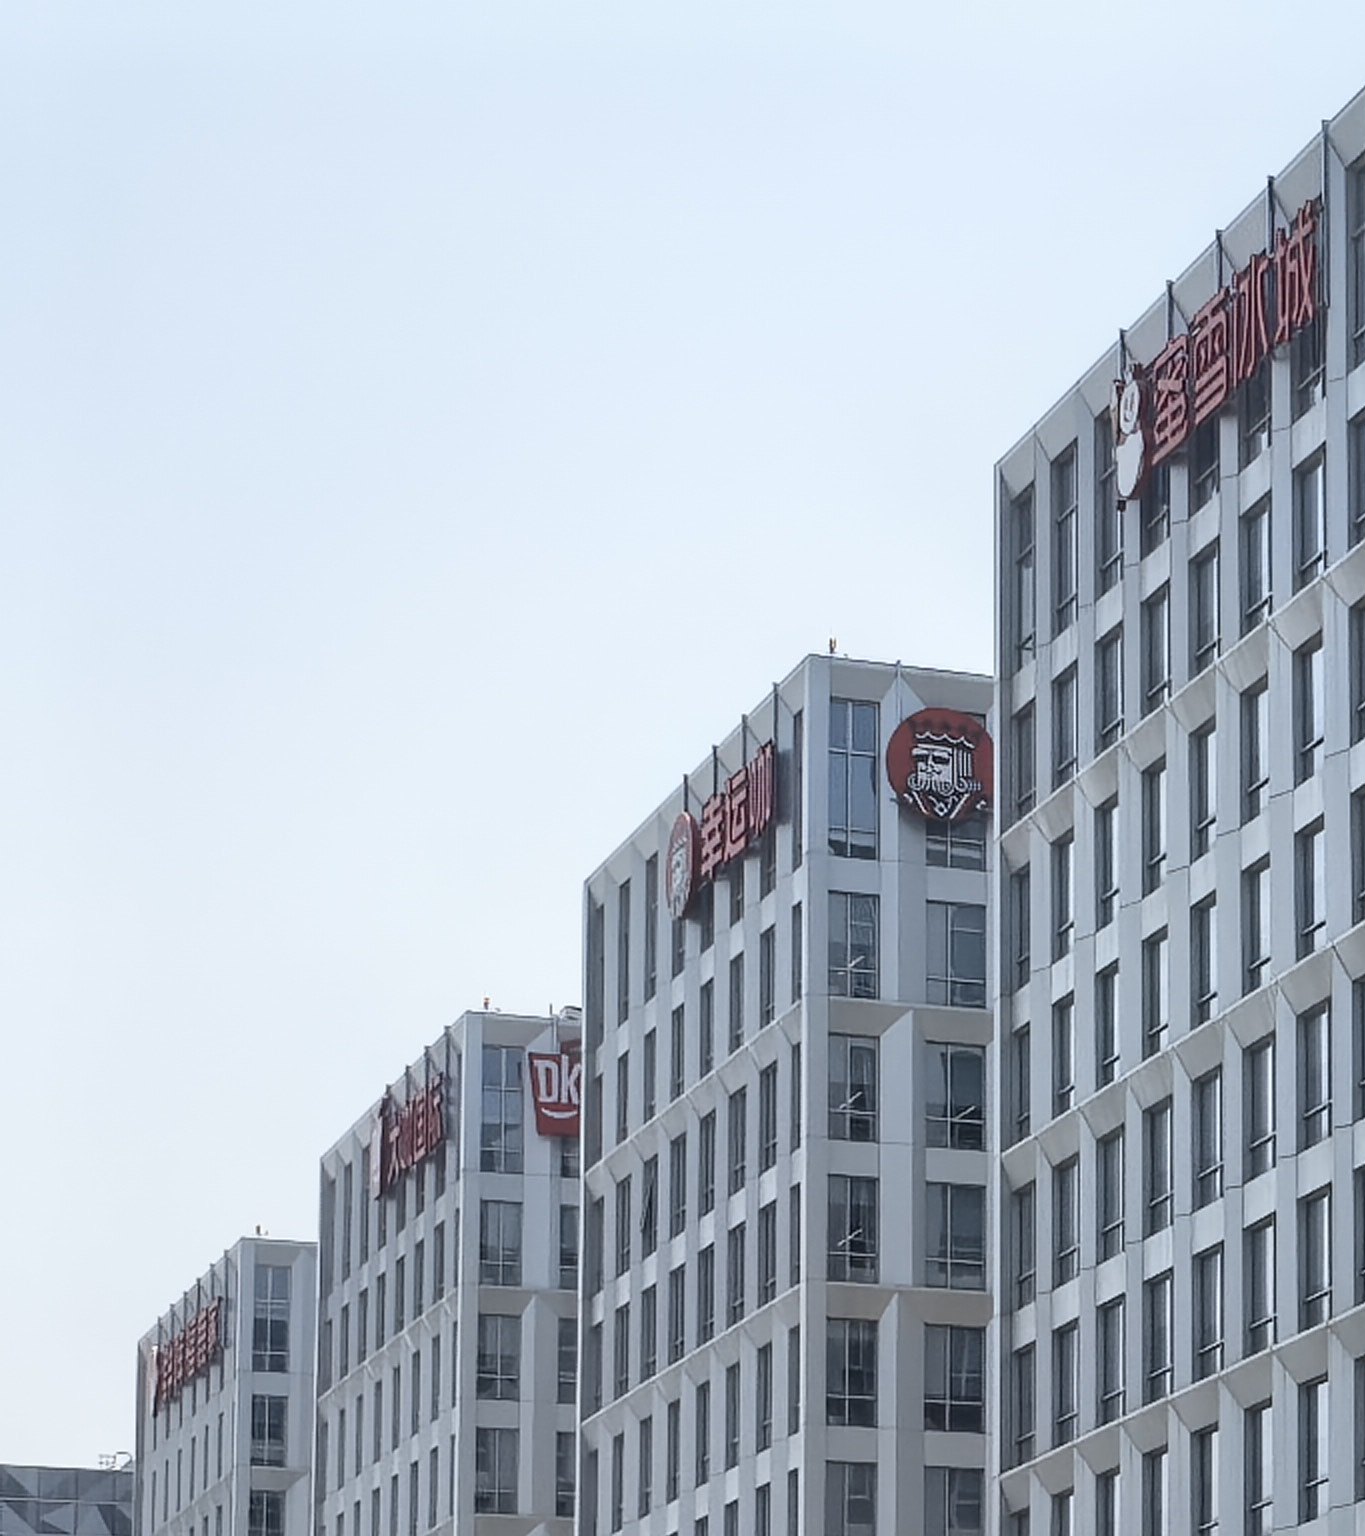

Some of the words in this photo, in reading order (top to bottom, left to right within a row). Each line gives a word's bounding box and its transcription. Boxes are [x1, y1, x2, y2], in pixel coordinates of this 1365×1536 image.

[1151, 199, 1320, 466] 蜜雪冰城
[700, 740, 774, 880] 幸运咖
